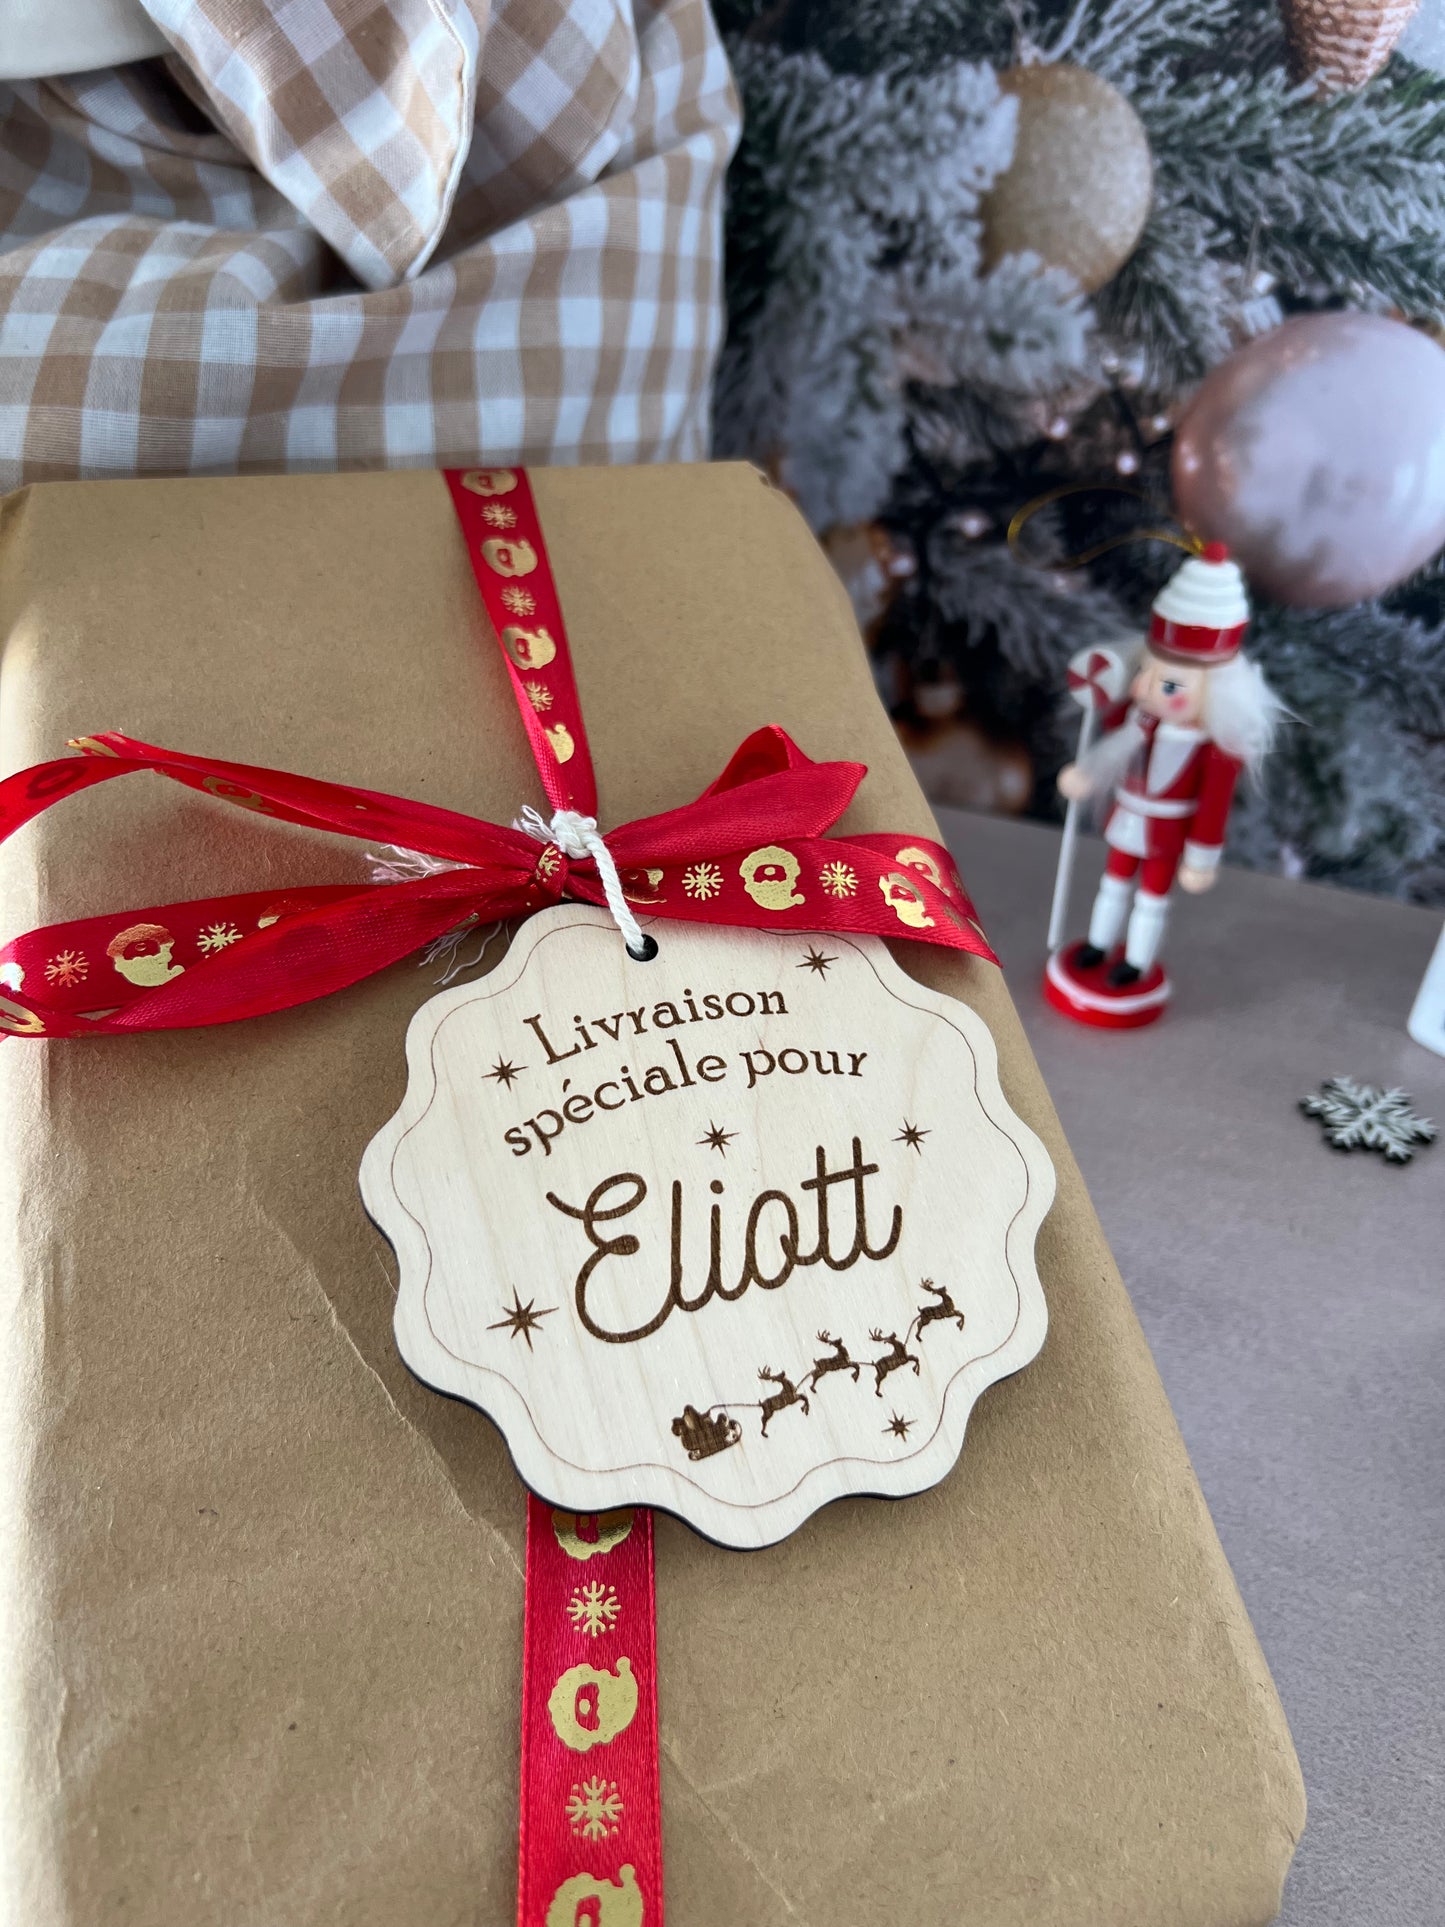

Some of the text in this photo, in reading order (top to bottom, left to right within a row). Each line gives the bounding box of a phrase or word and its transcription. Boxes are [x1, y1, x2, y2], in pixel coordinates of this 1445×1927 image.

[523, 988, 789, 1066] Livraison
[503, 1037, 868, 1157] spéciale pour
[546, 1136, 902, 1344] Eliott
